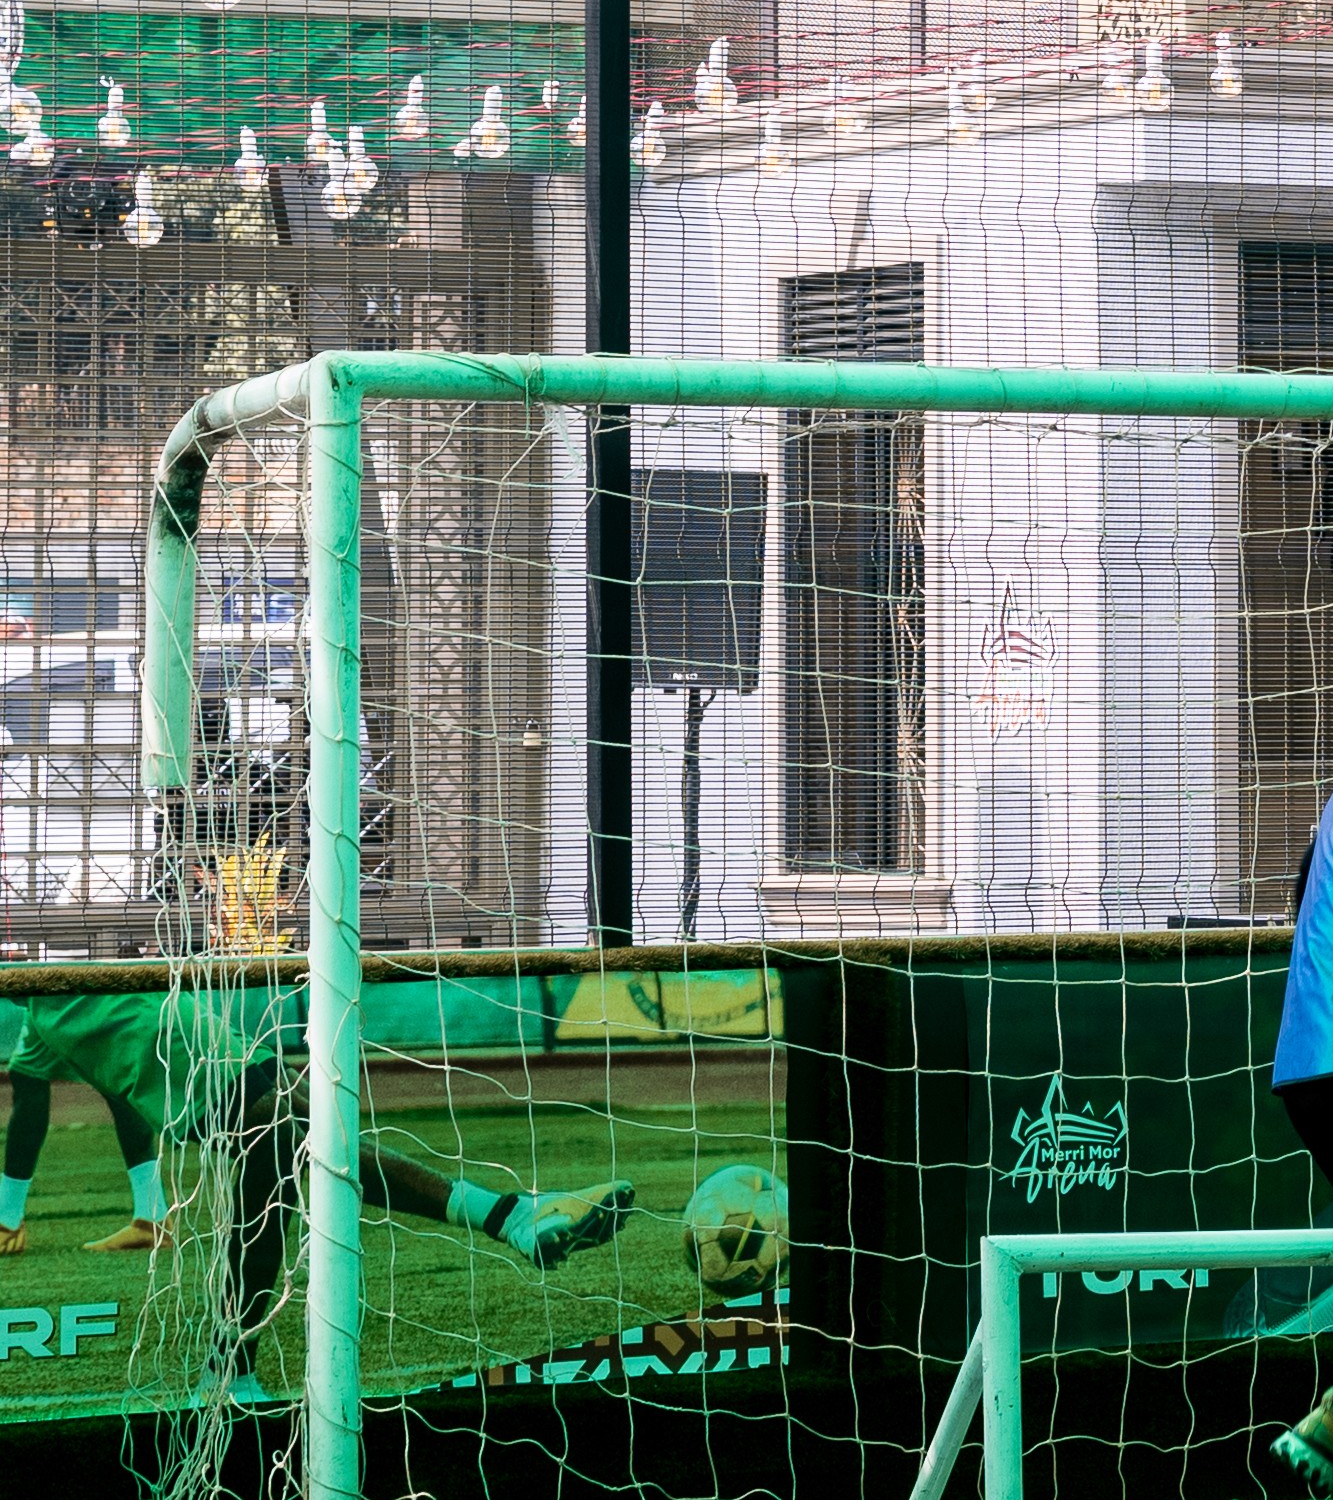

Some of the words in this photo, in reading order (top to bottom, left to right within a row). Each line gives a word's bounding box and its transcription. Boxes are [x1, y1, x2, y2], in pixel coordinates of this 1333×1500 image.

[998, 1136, 1117, 1203] Arena
[1041, 1144, 1085, 1162] Merri
[1088, 1144, 1121, 1160] Mor
